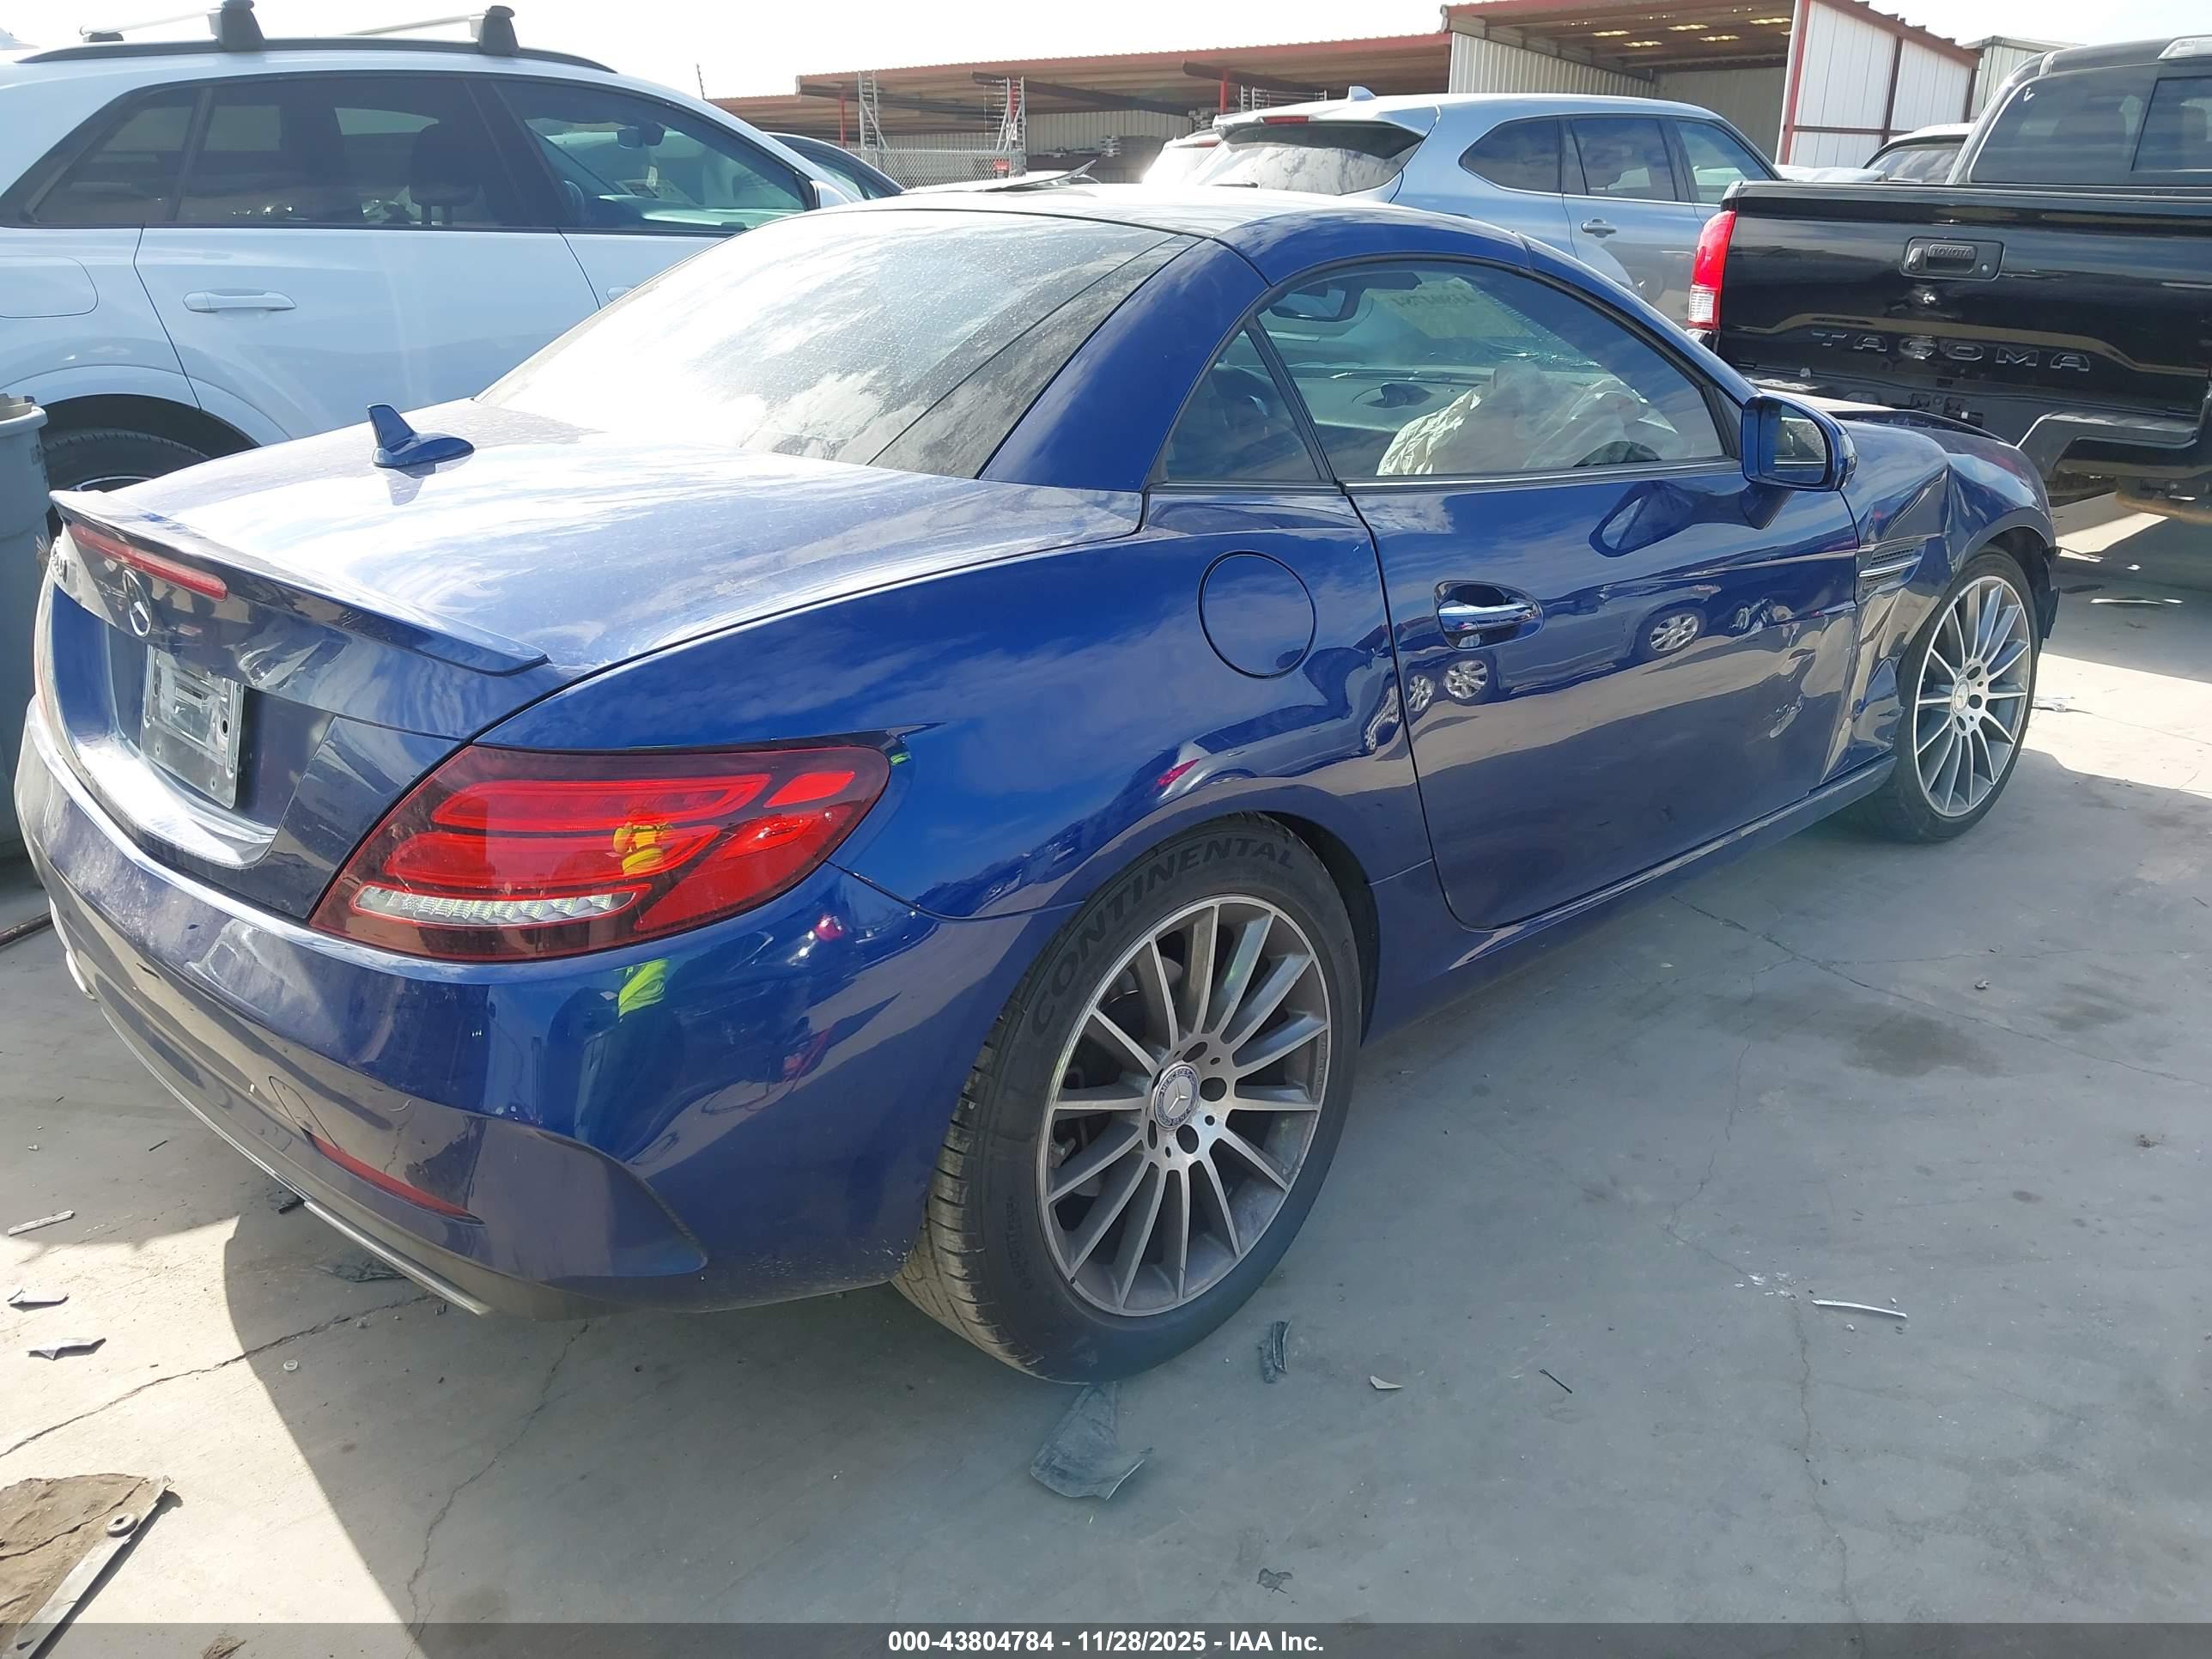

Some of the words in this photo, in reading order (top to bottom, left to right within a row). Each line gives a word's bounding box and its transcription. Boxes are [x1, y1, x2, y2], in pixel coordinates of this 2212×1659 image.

[1930, 246, 1972, 257] TOYOTA
[1811, 331, 2091, 372] TACOMA
[1031, 836, 1295, 1032] CONTINENTAL
